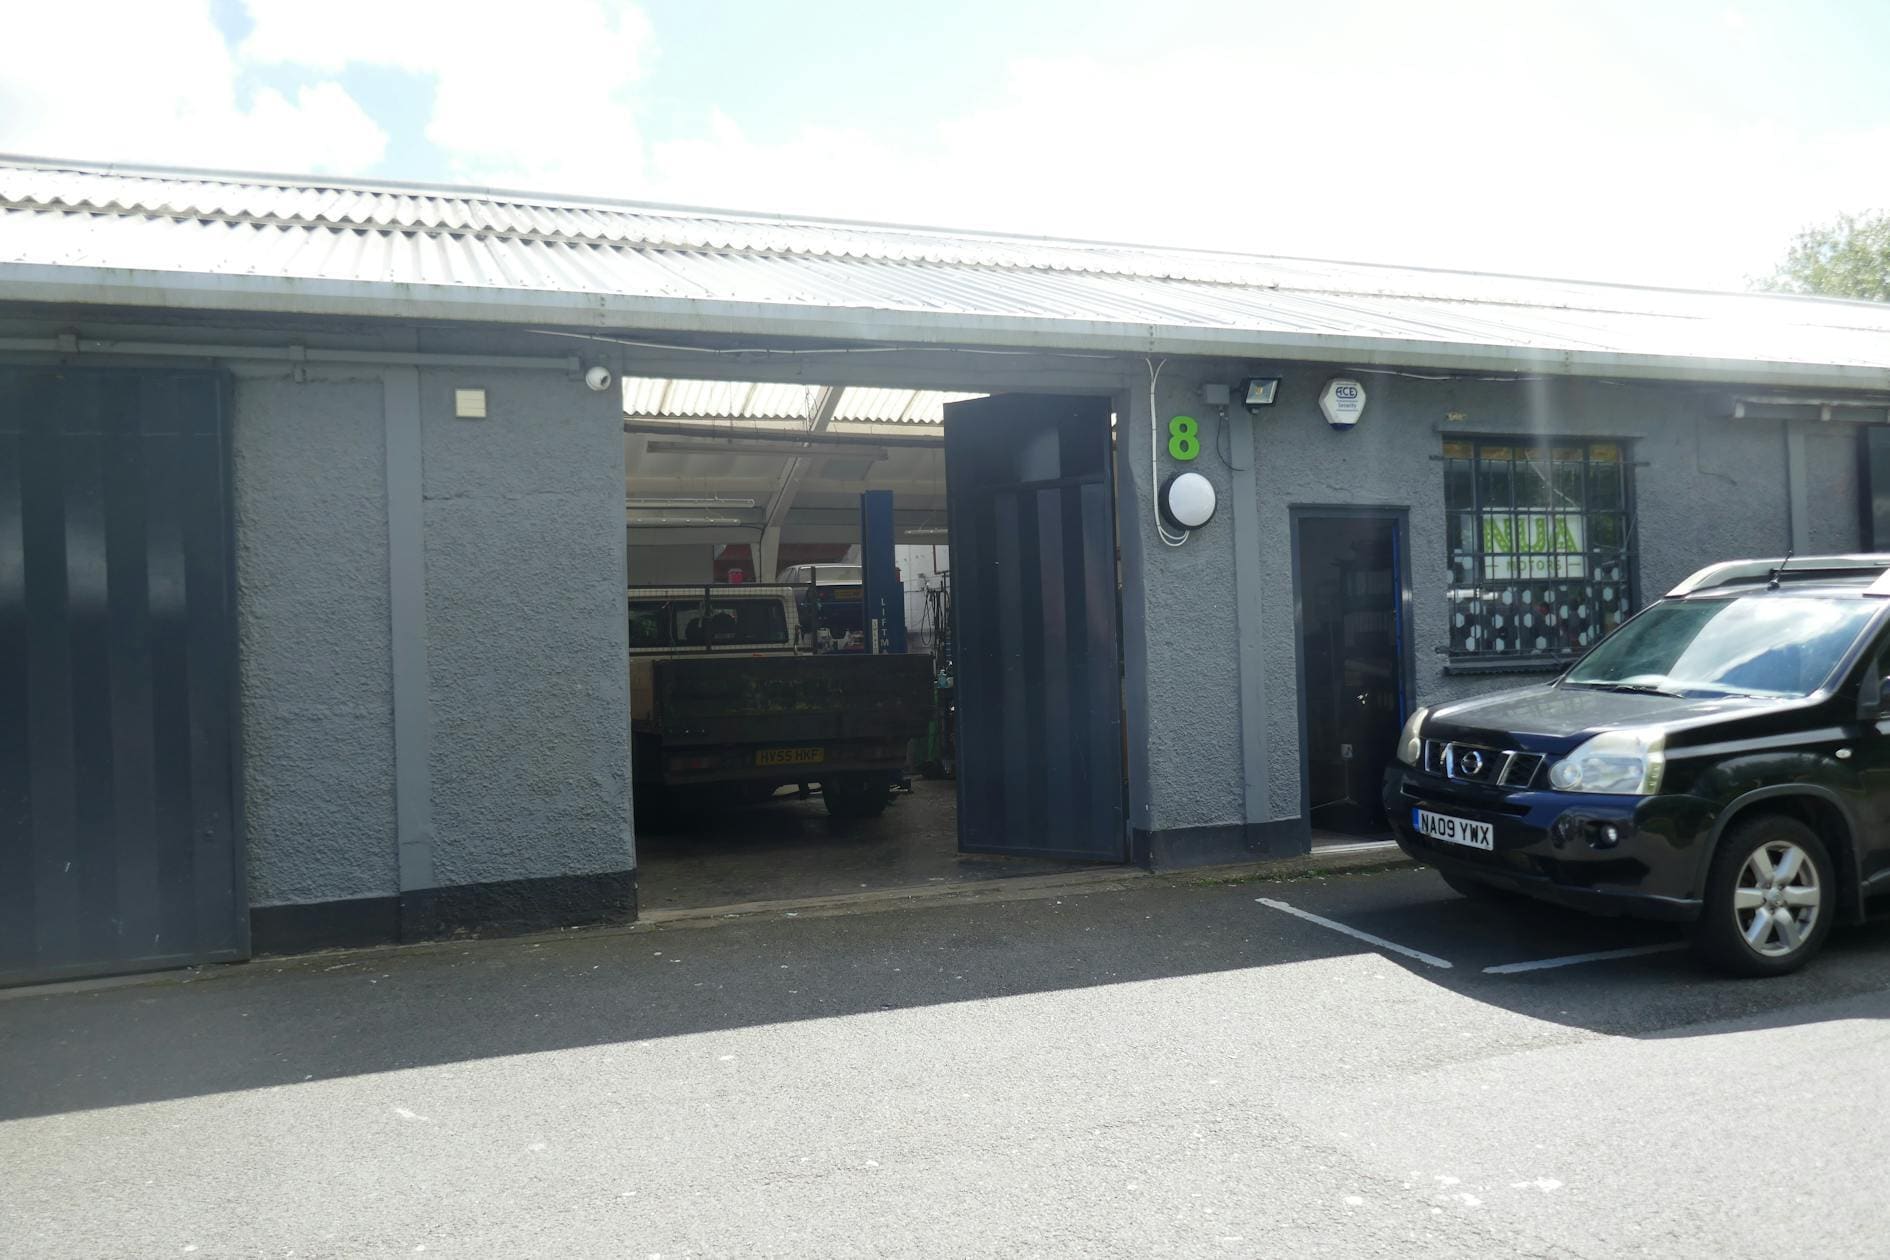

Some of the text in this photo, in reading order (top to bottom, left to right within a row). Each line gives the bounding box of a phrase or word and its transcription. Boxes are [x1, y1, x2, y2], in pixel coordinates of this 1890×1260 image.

[1336, 387, 1356, 397] ACE
[1168, 415, 1200, 460] 8
[1484, 517, 1578, 553] NUA
[1506, 560, 1561, 571] MOTORS
[1421, 813, 1489, 846] NA09 YWX
